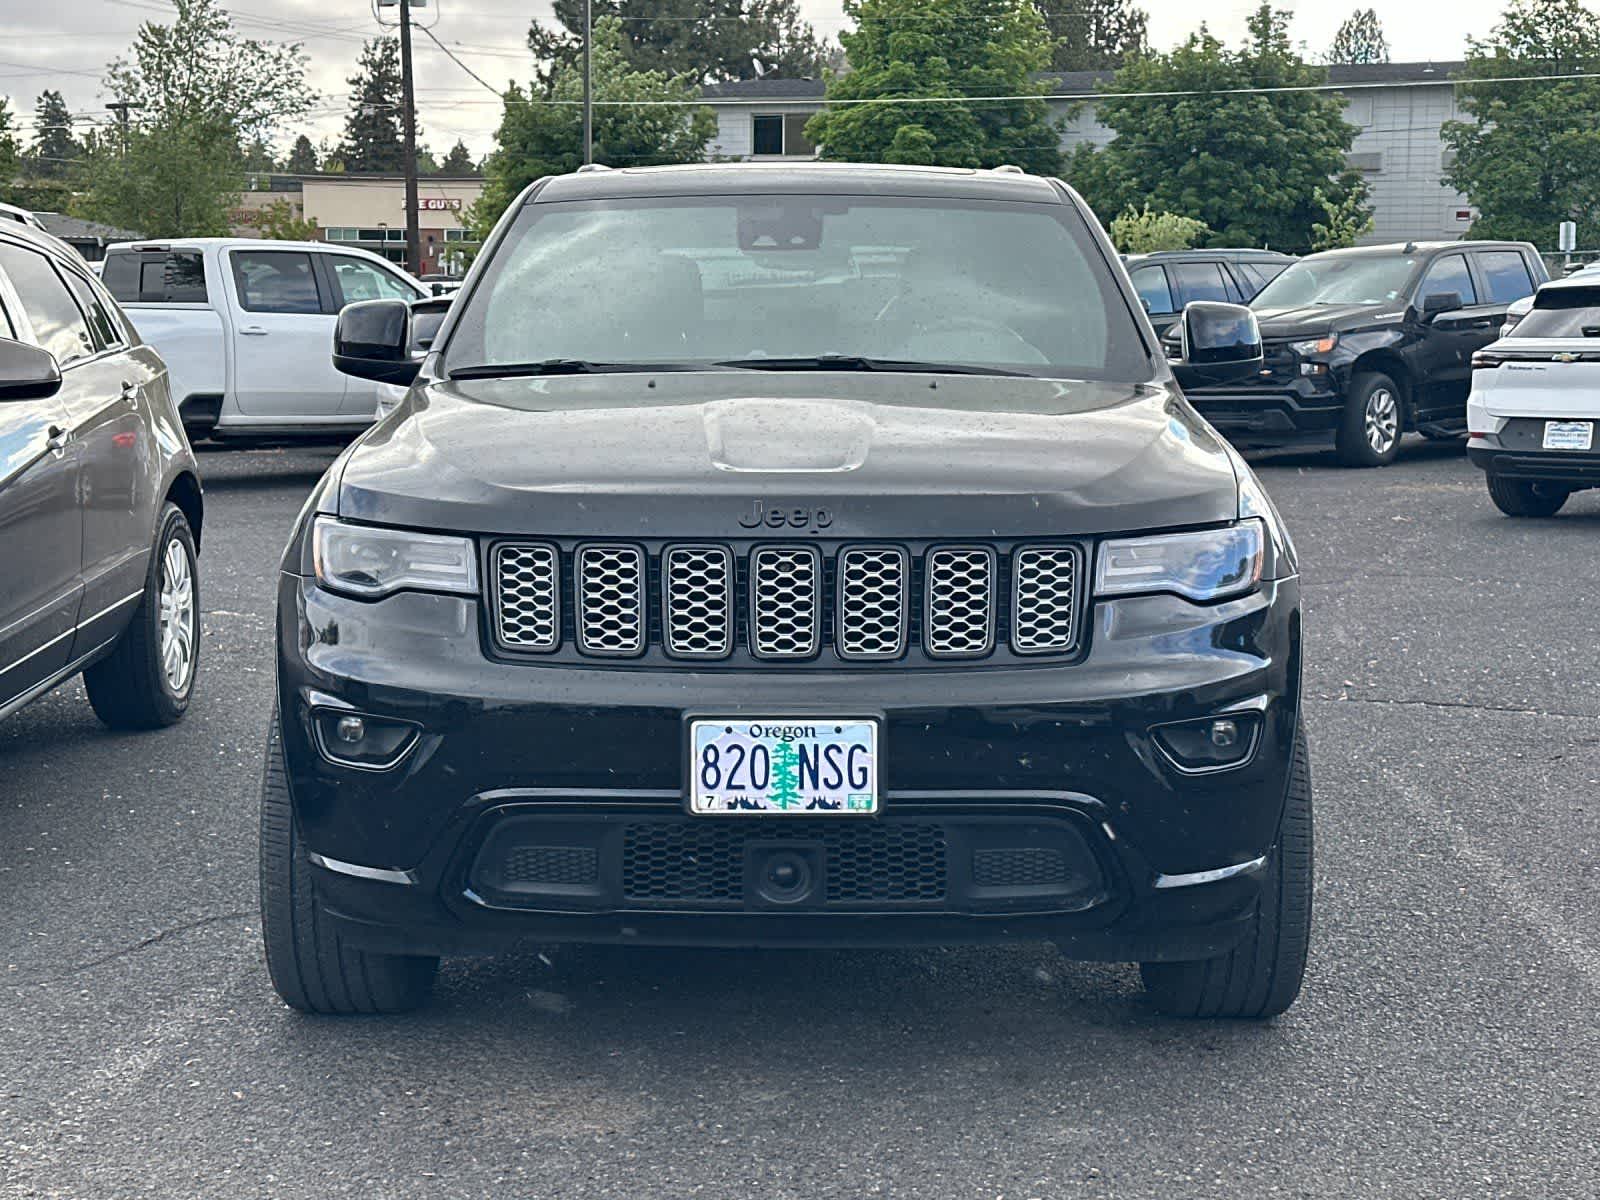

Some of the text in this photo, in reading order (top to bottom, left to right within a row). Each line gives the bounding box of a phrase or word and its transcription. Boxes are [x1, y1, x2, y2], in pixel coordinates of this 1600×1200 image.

[401, 199, 460, 209] FE GUYS
[738, 498, 833, 534] Jeep
[750, 724, 817, 742] Oregon
[701, 743, 868, 790] 820 NSG
[706, 796, 715, 808] 7
